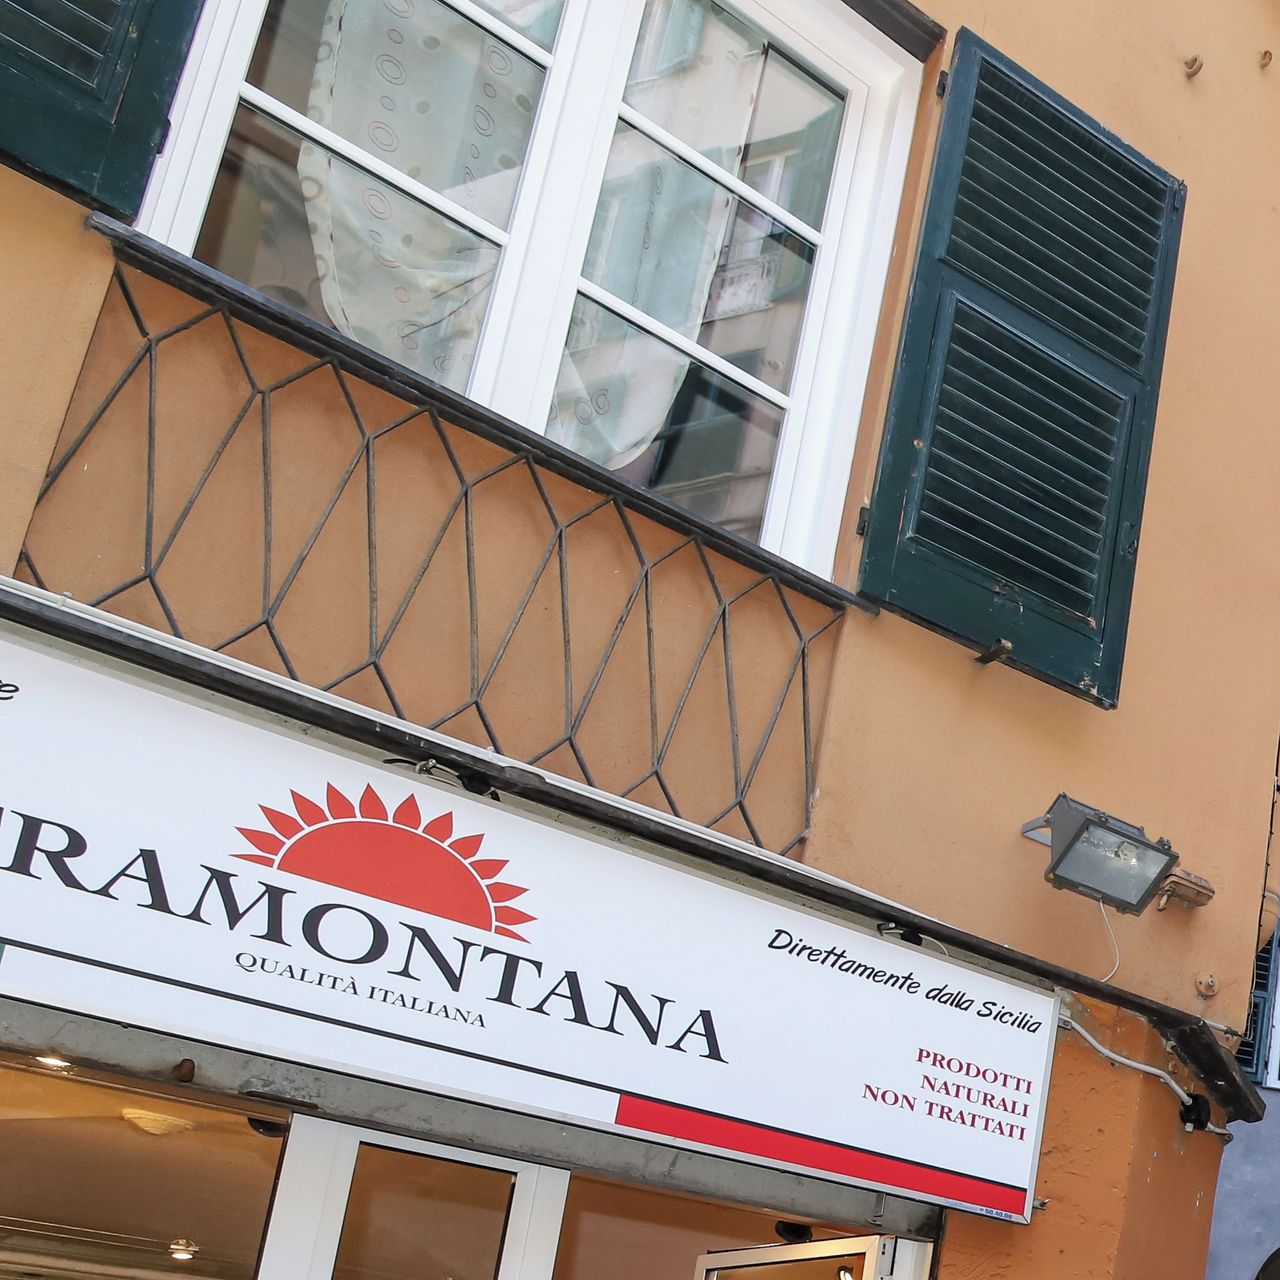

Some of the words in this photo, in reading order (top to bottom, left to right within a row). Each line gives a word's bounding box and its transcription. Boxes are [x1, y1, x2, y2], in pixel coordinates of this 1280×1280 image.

[0, 806, 729, 1064] RAMONTANA
[235, 951, 360, 996] QUALITÀ
[368, 985, 487, 1029] ITALIANA
[767, 928, 919, 996] Direttamente
[925, 982, 974, 1013] dalla
[977, 998, 1043, 1034] Sicilia
[916, 1047, 1033, 1096] PRODOTTI
[919, 1073, 1030, 1118] NATURALI
[862, 1083, 917, 1114] NON
[924, 1099, 1027, 1142] TRATTATI
